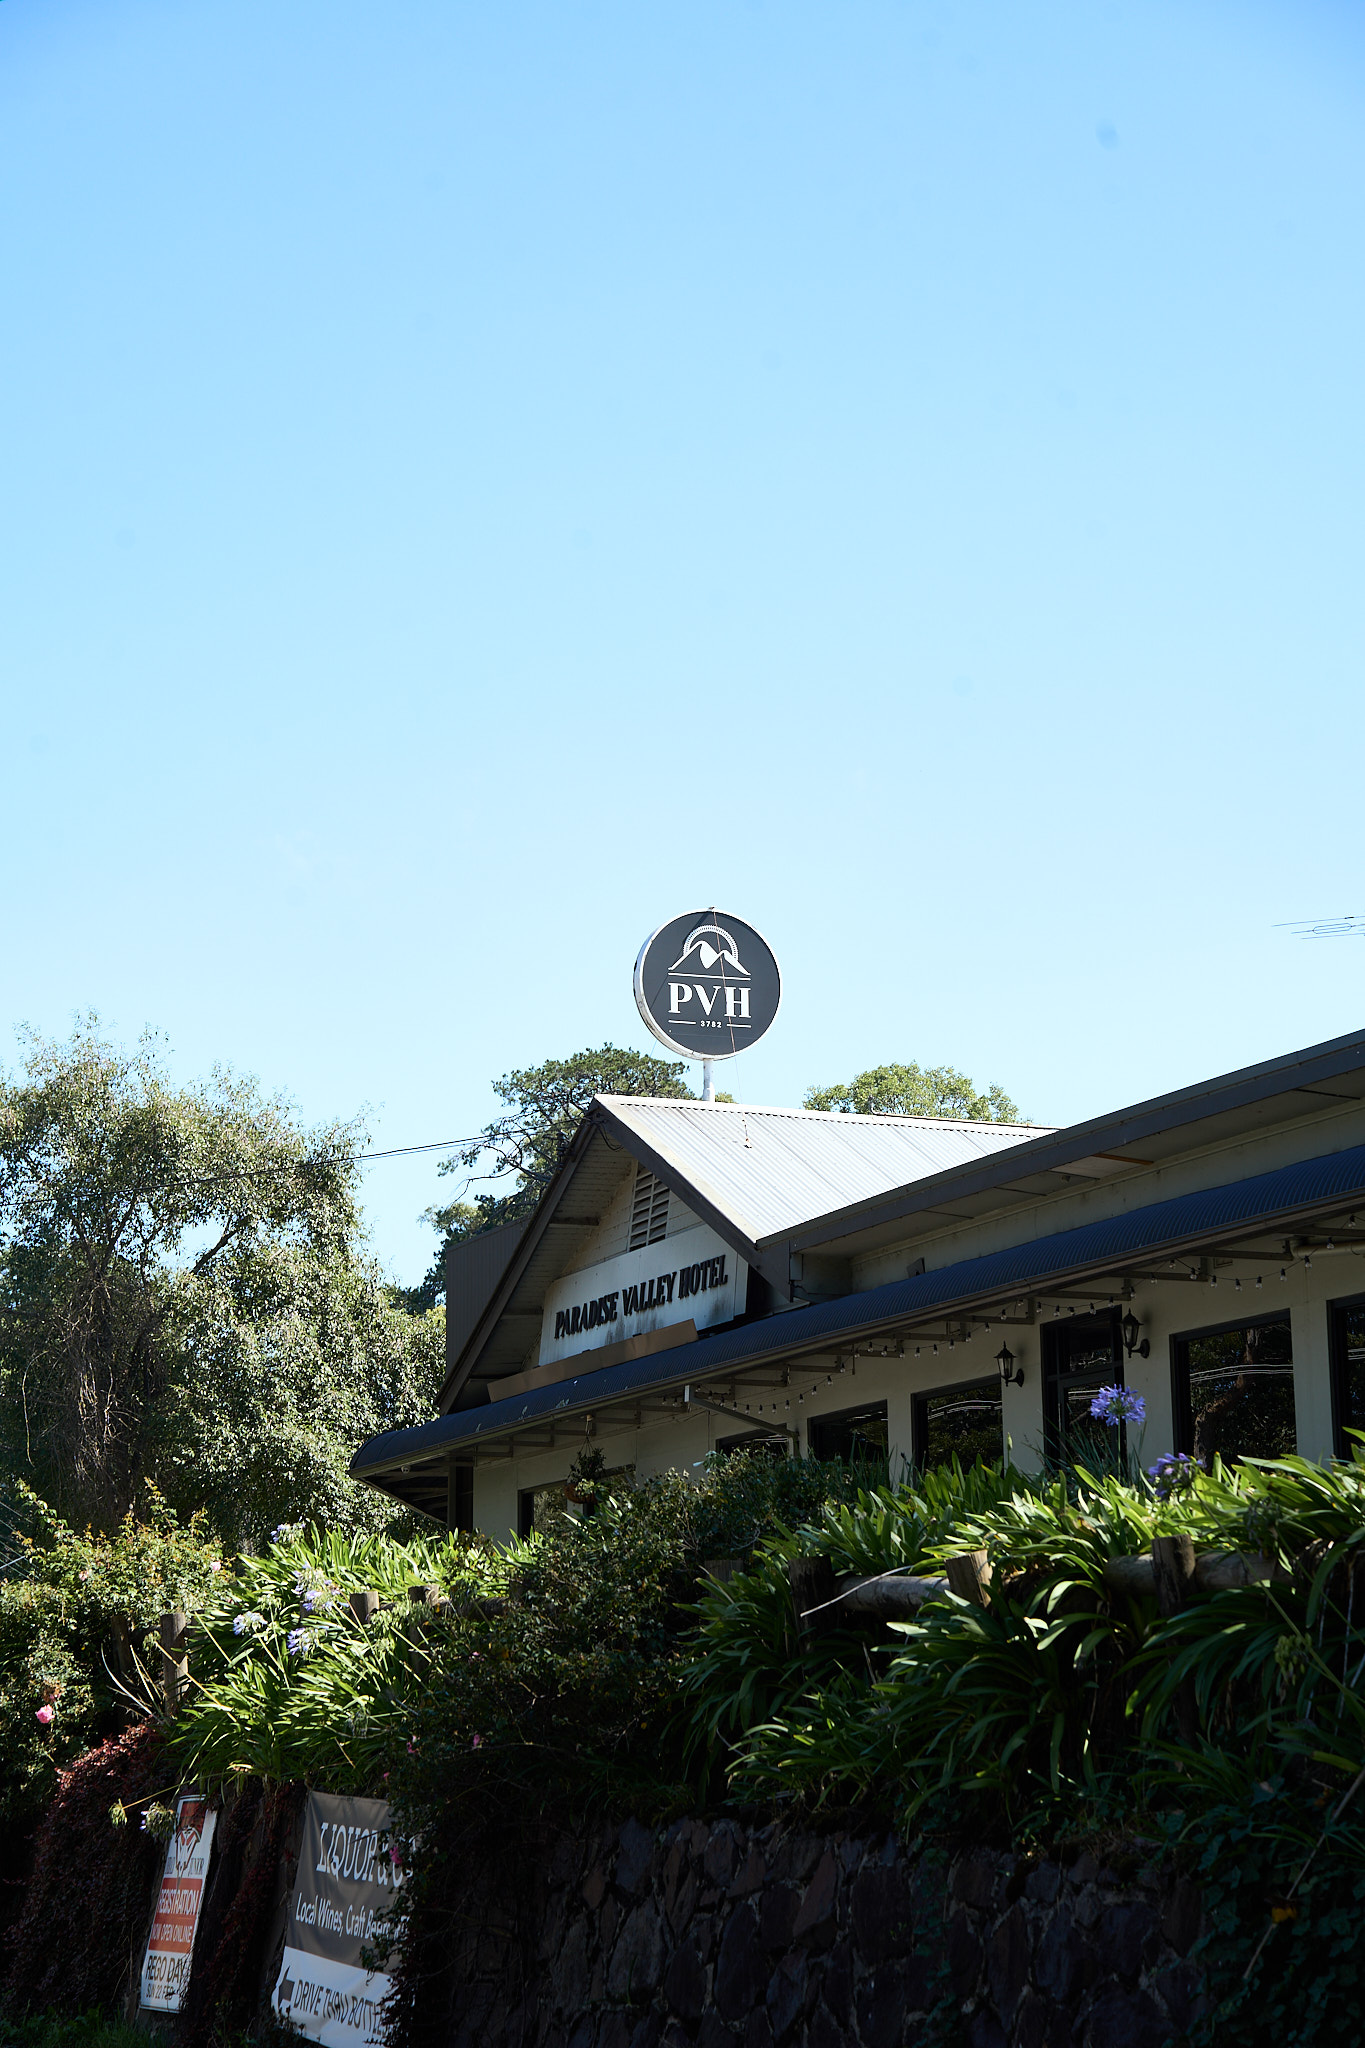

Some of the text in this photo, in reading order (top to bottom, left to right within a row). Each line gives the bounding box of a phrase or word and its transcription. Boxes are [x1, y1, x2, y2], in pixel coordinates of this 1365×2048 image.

[667, 982, 752, 1019] PVH
[700, 1020, 722, 1028] 3782
[554, 1254, 728, 1340] PARADISE VALLEY HOTEL
[316, 1822, 378, 1882] LIQUOR
[157, 1888, 199, 1915] REGISTRATION
[295, 1892, 318, 1926] Local
[317, 1897, 344, 1937] Wines,
[345, 1904, 366, 1939] Craft
[160, 1924, 174, 1941] OPEN
[172, 1925, 193, 1943] ONLINE
[145, 1955, 167, 1982] REGO
[145, 1983, 156, 1998] SUN
[293, 1979, 324, 2017] DRIVE
[322, 1988, 349, 2024] THRU
